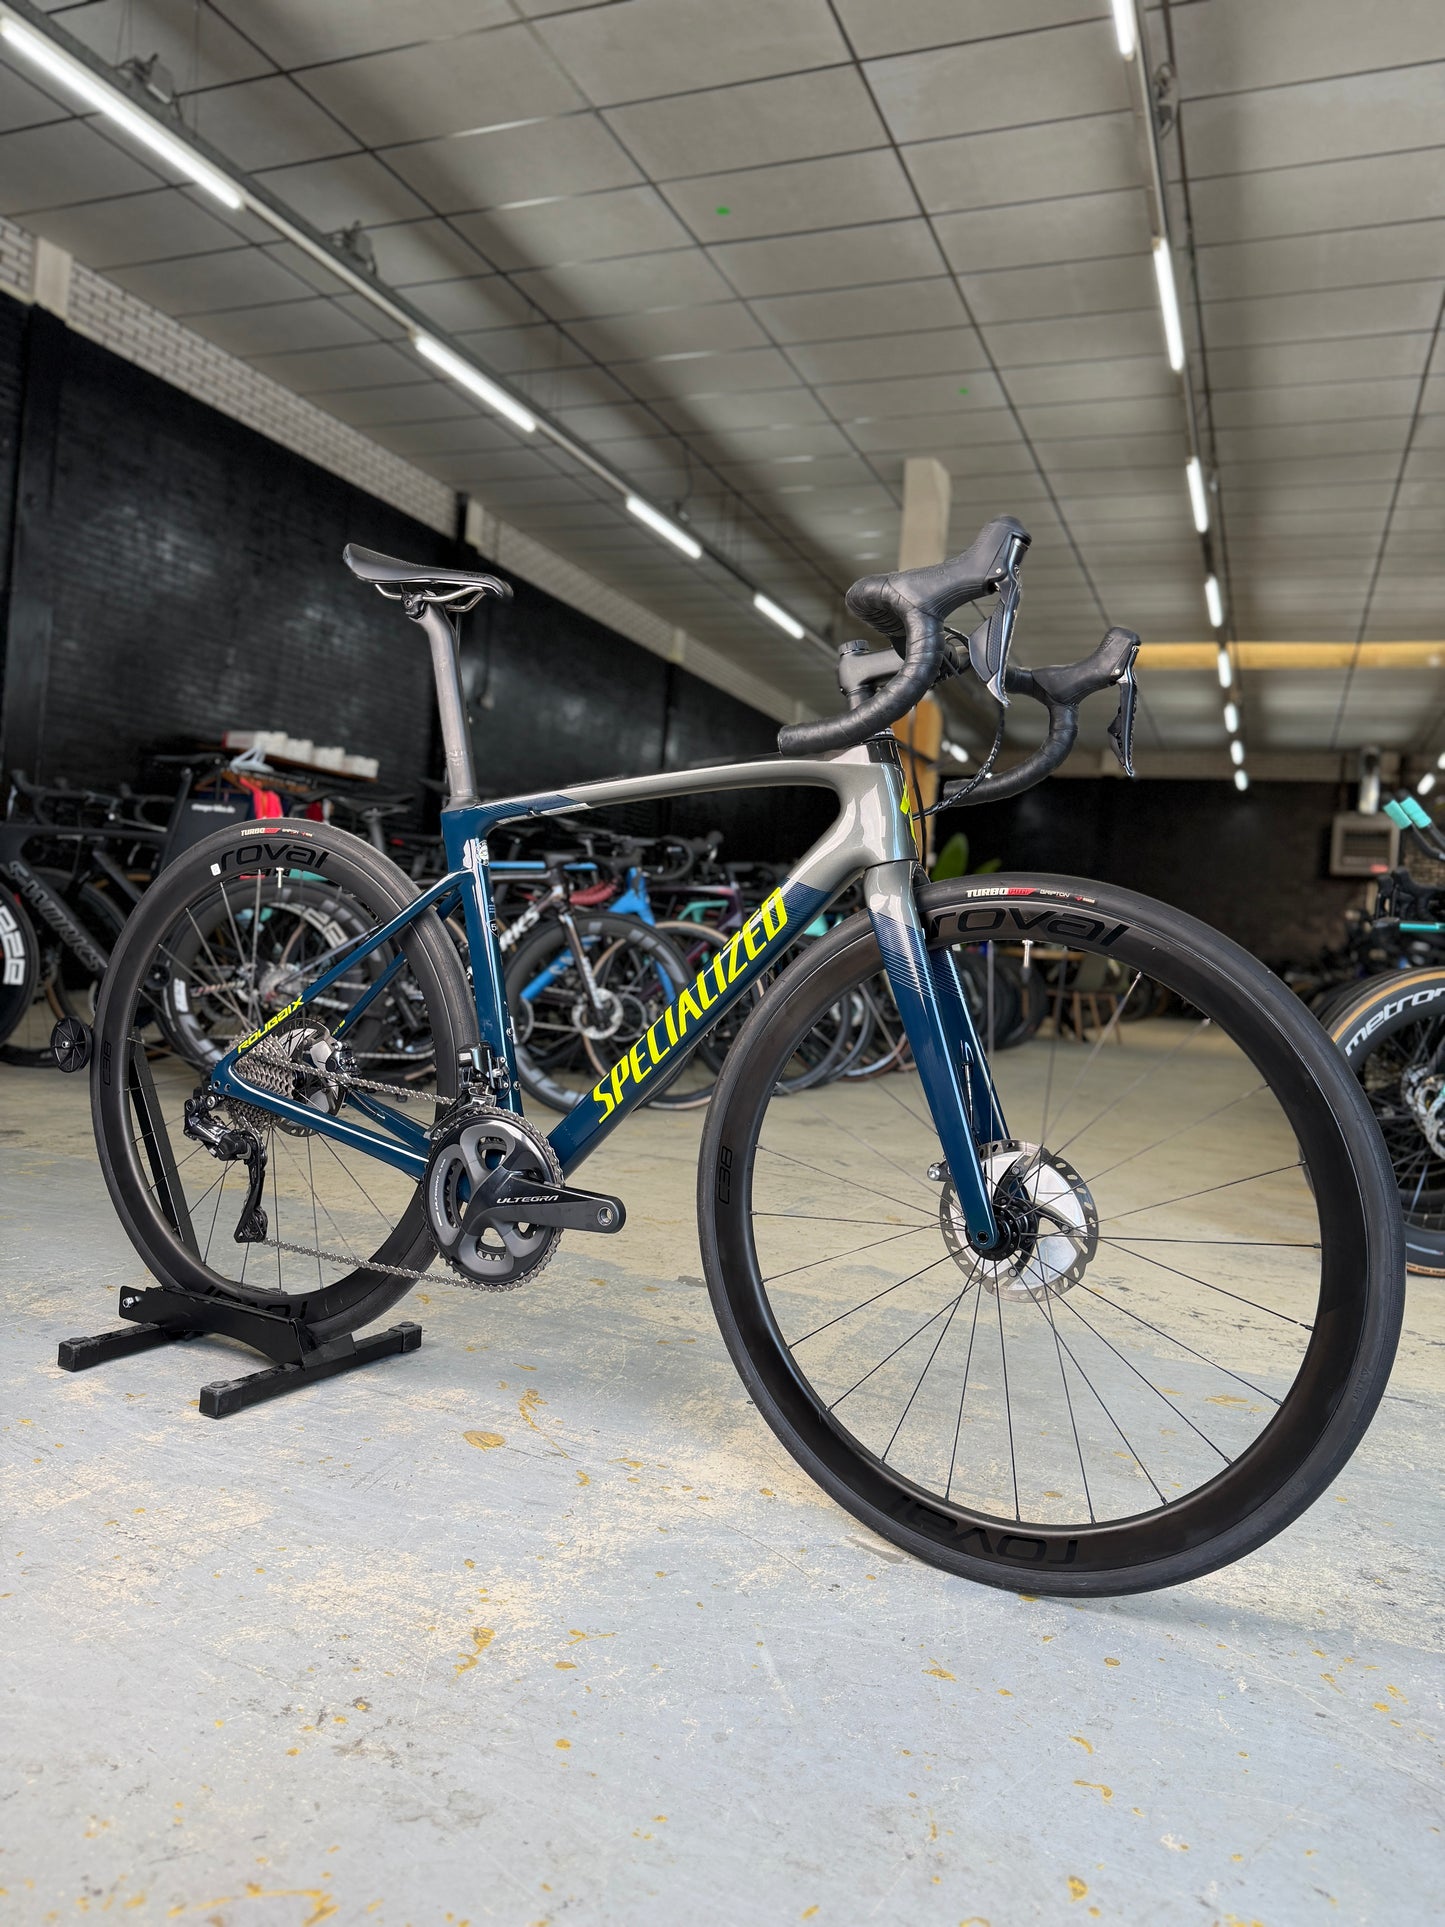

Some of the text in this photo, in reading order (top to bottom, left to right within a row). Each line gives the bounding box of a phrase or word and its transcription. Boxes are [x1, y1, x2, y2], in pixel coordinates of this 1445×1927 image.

[241, 828, 266, 836] TURBO
[220, 844, 330, 872] roval
[966, 887, 1008, 898] TURBO
[931, 908, 1130, 947] roval
[593, 887, 788, 1123] SPECIALIZED
[718, 1145, 733, 1205] C38
[496, 1195, 559, 1204] ULTEGRA
